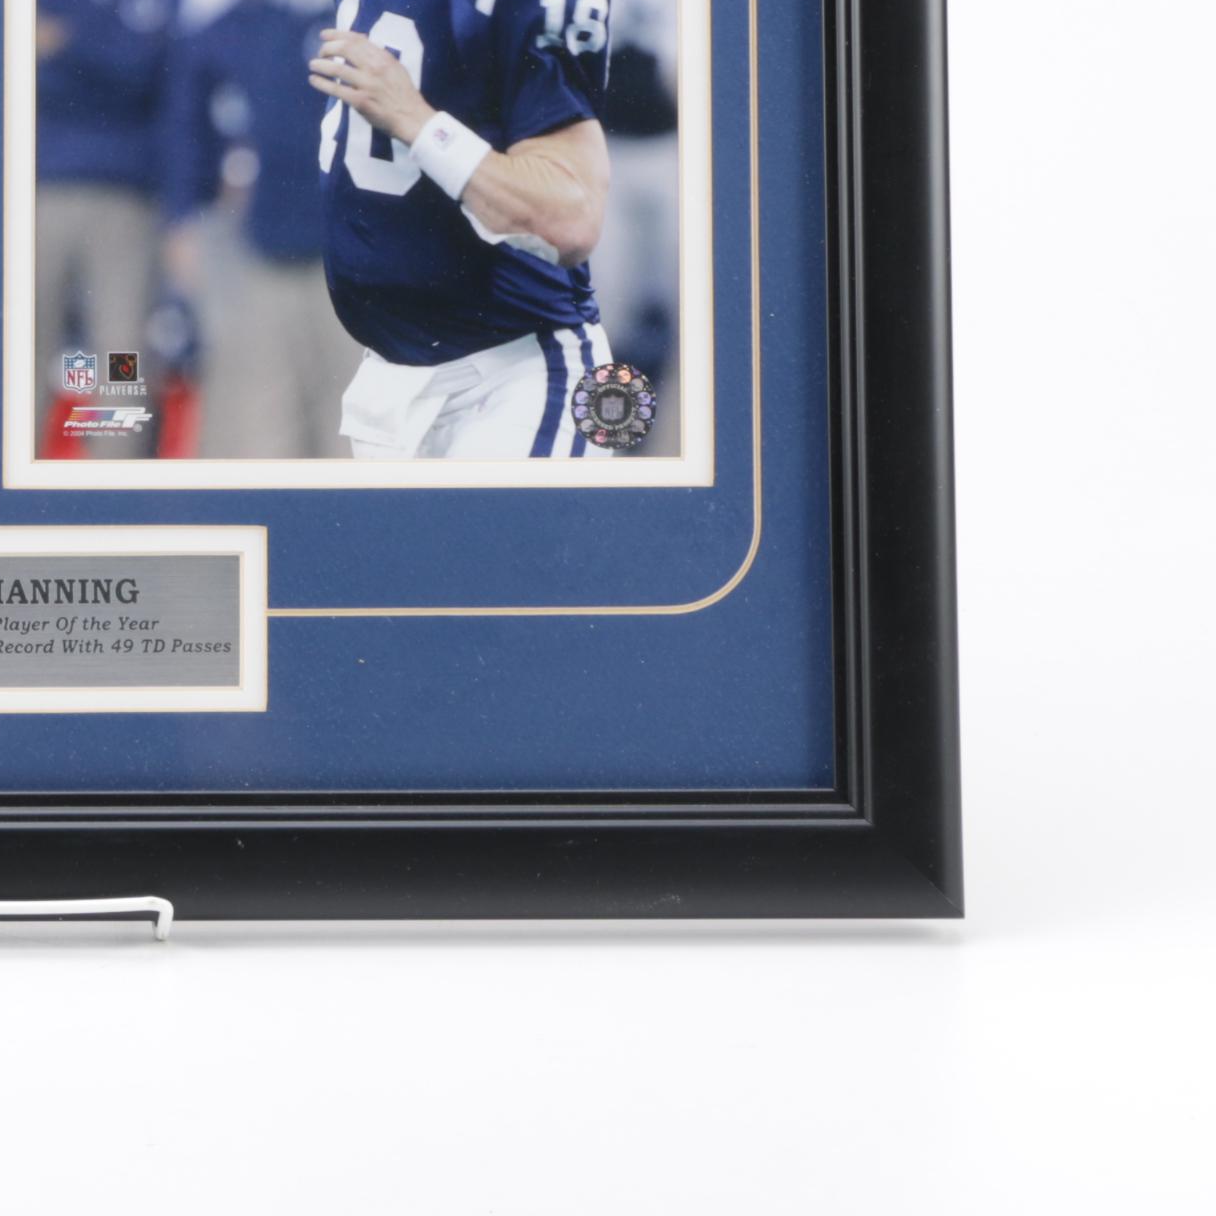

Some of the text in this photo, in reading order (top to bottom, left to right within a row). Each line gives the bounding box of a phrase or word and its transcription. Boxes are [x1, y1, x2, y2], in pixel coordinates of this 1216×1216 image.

[66, 369, 94, 387] NFL
[99, 384, 138, 396] PLAYERS
[64, 420, 121, 428] Photo File
[55, 616, 78, 634] Of
[82, 616, 112, 632] the
[118, 616, 160, 632] Year
[62, 638, 105, 654] With
[111, 638, 134, 654] 49
[141, 638, 166, 654] TD
[171, 638, 232, 654] Passes
